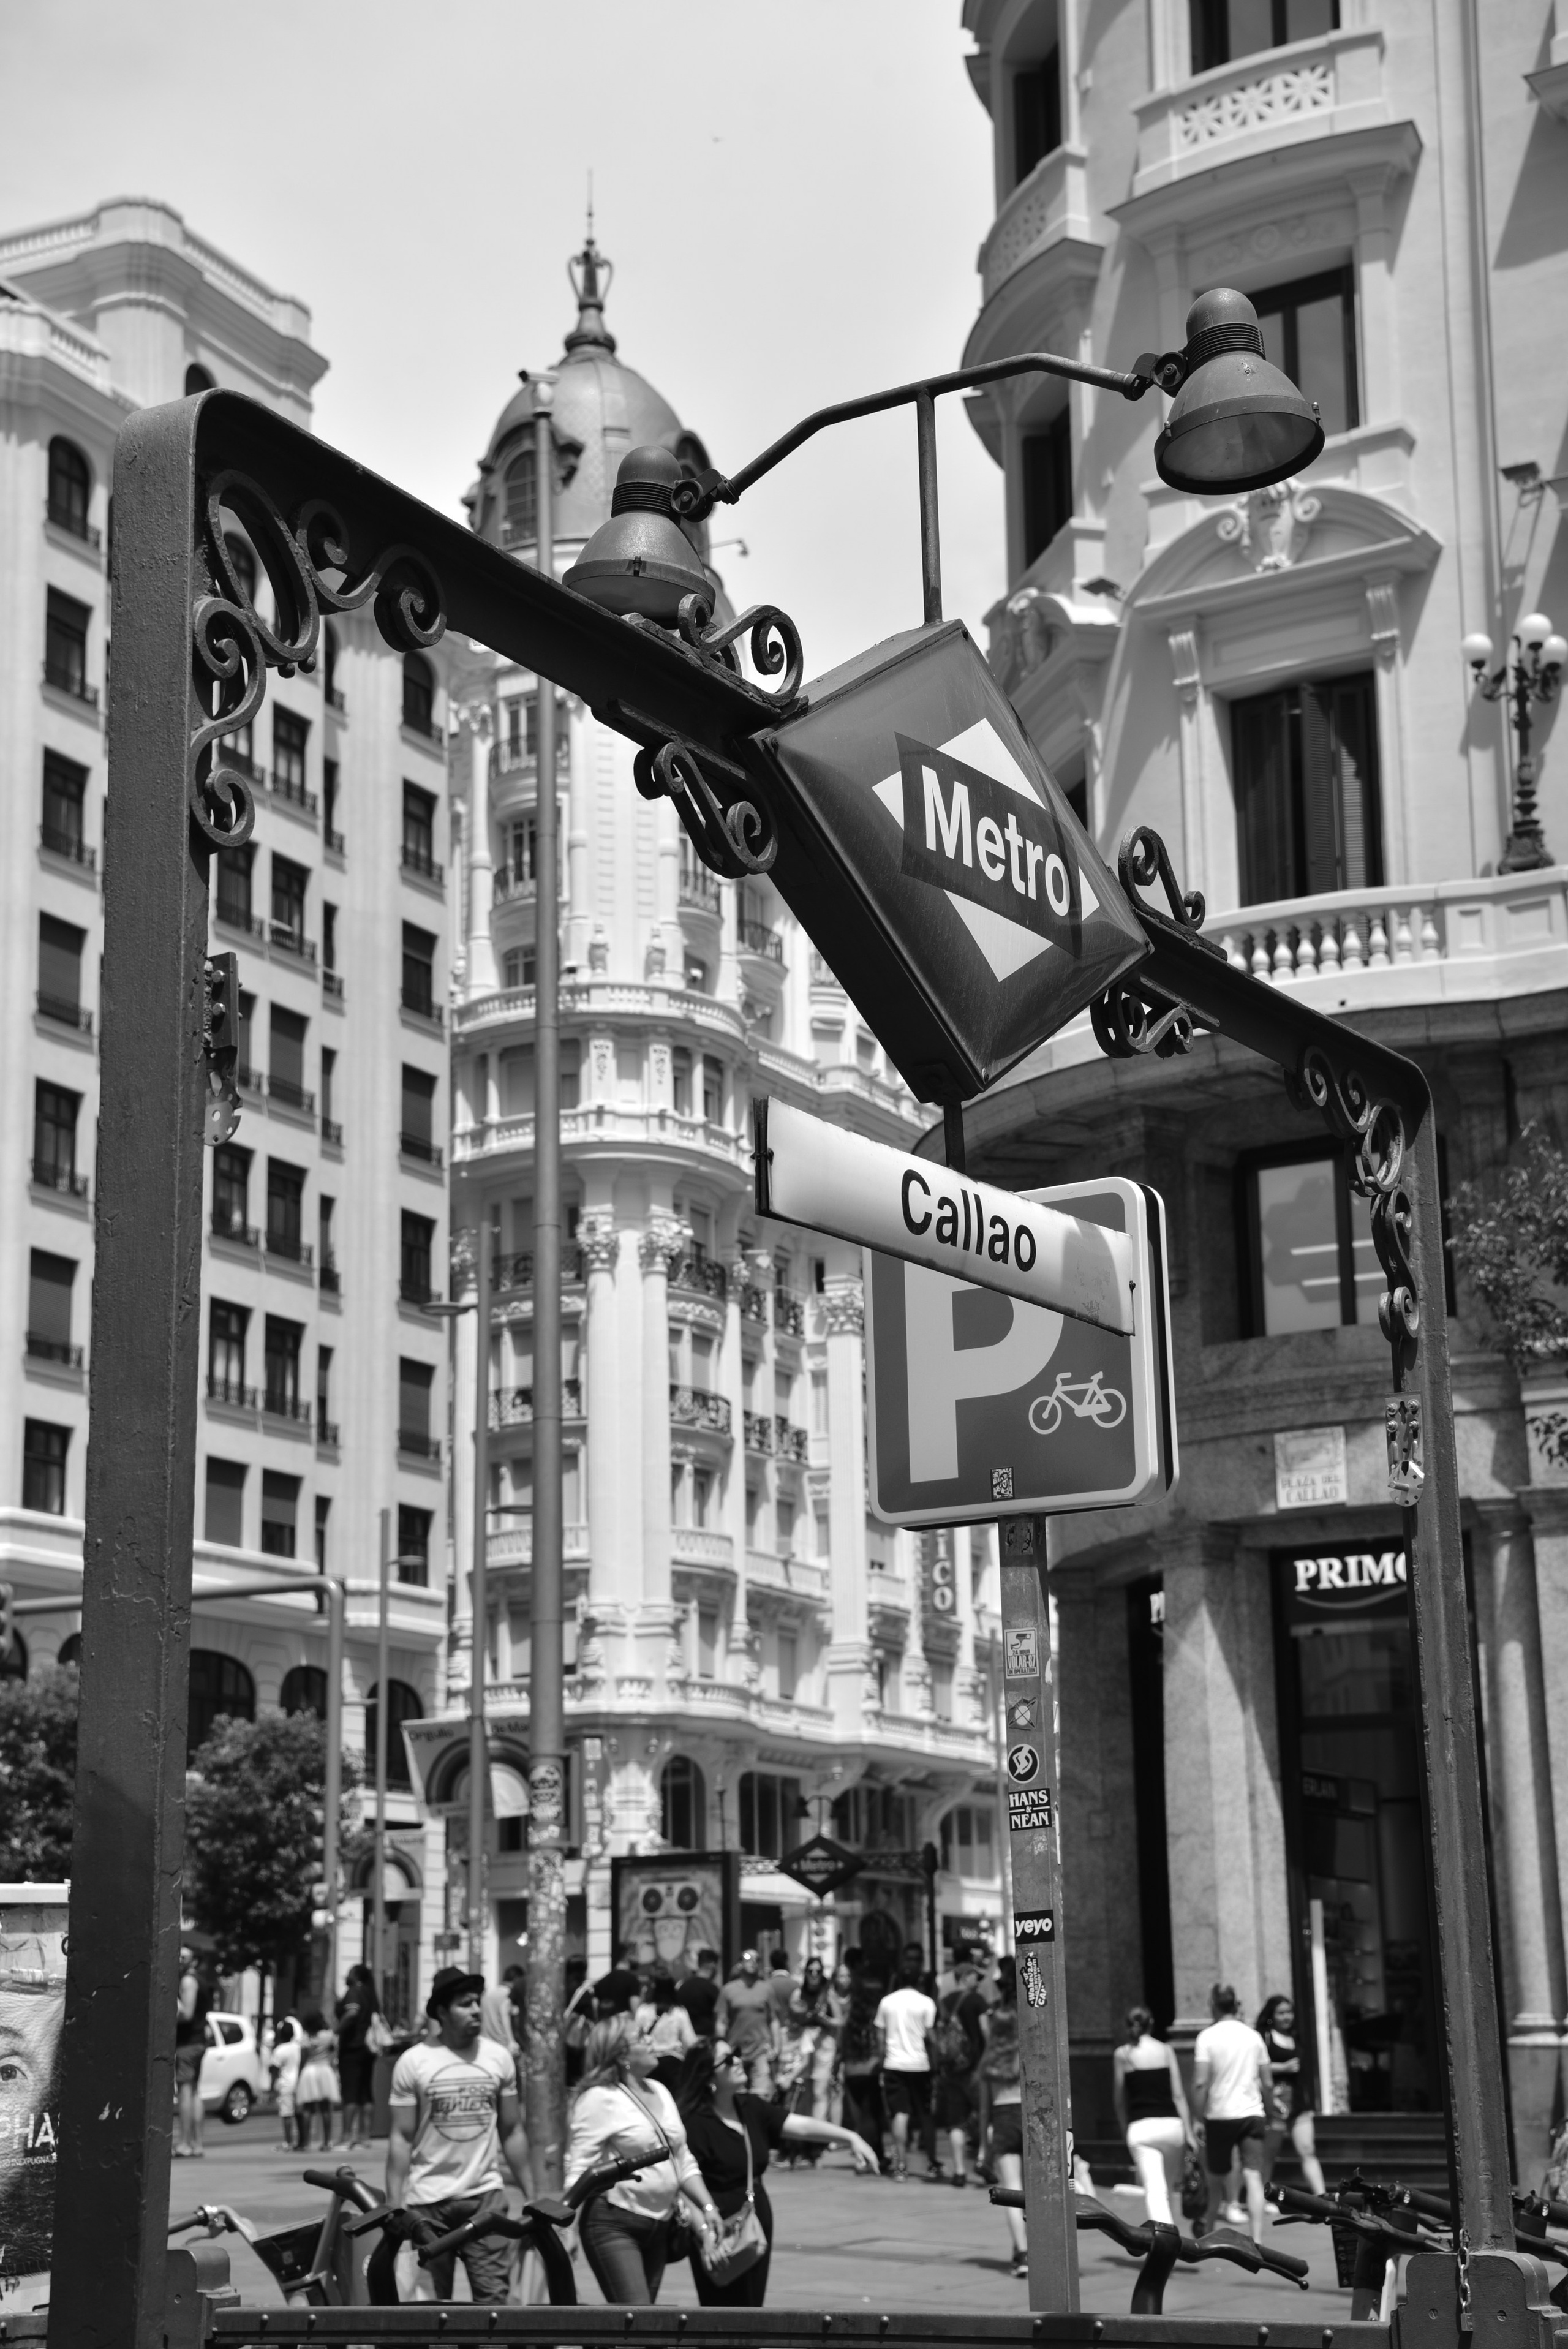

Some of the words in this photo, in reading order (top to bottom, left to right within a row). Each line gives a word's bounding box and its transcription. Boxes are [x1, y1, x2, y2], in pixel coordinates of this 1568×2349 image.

[921, 764, 1071, 916] Metro
[901, 1169, 1036, 1272] Callao
[903, 1261, 1064, 1484] P
[1008, 1654, 1036, 1669] VOLAR-87
[1009, 1790, 1049, 1808] HANS
[1011, 1811, 1050, 1829] NEAN
[1015, 1917, 1052, 1937] yeyo
